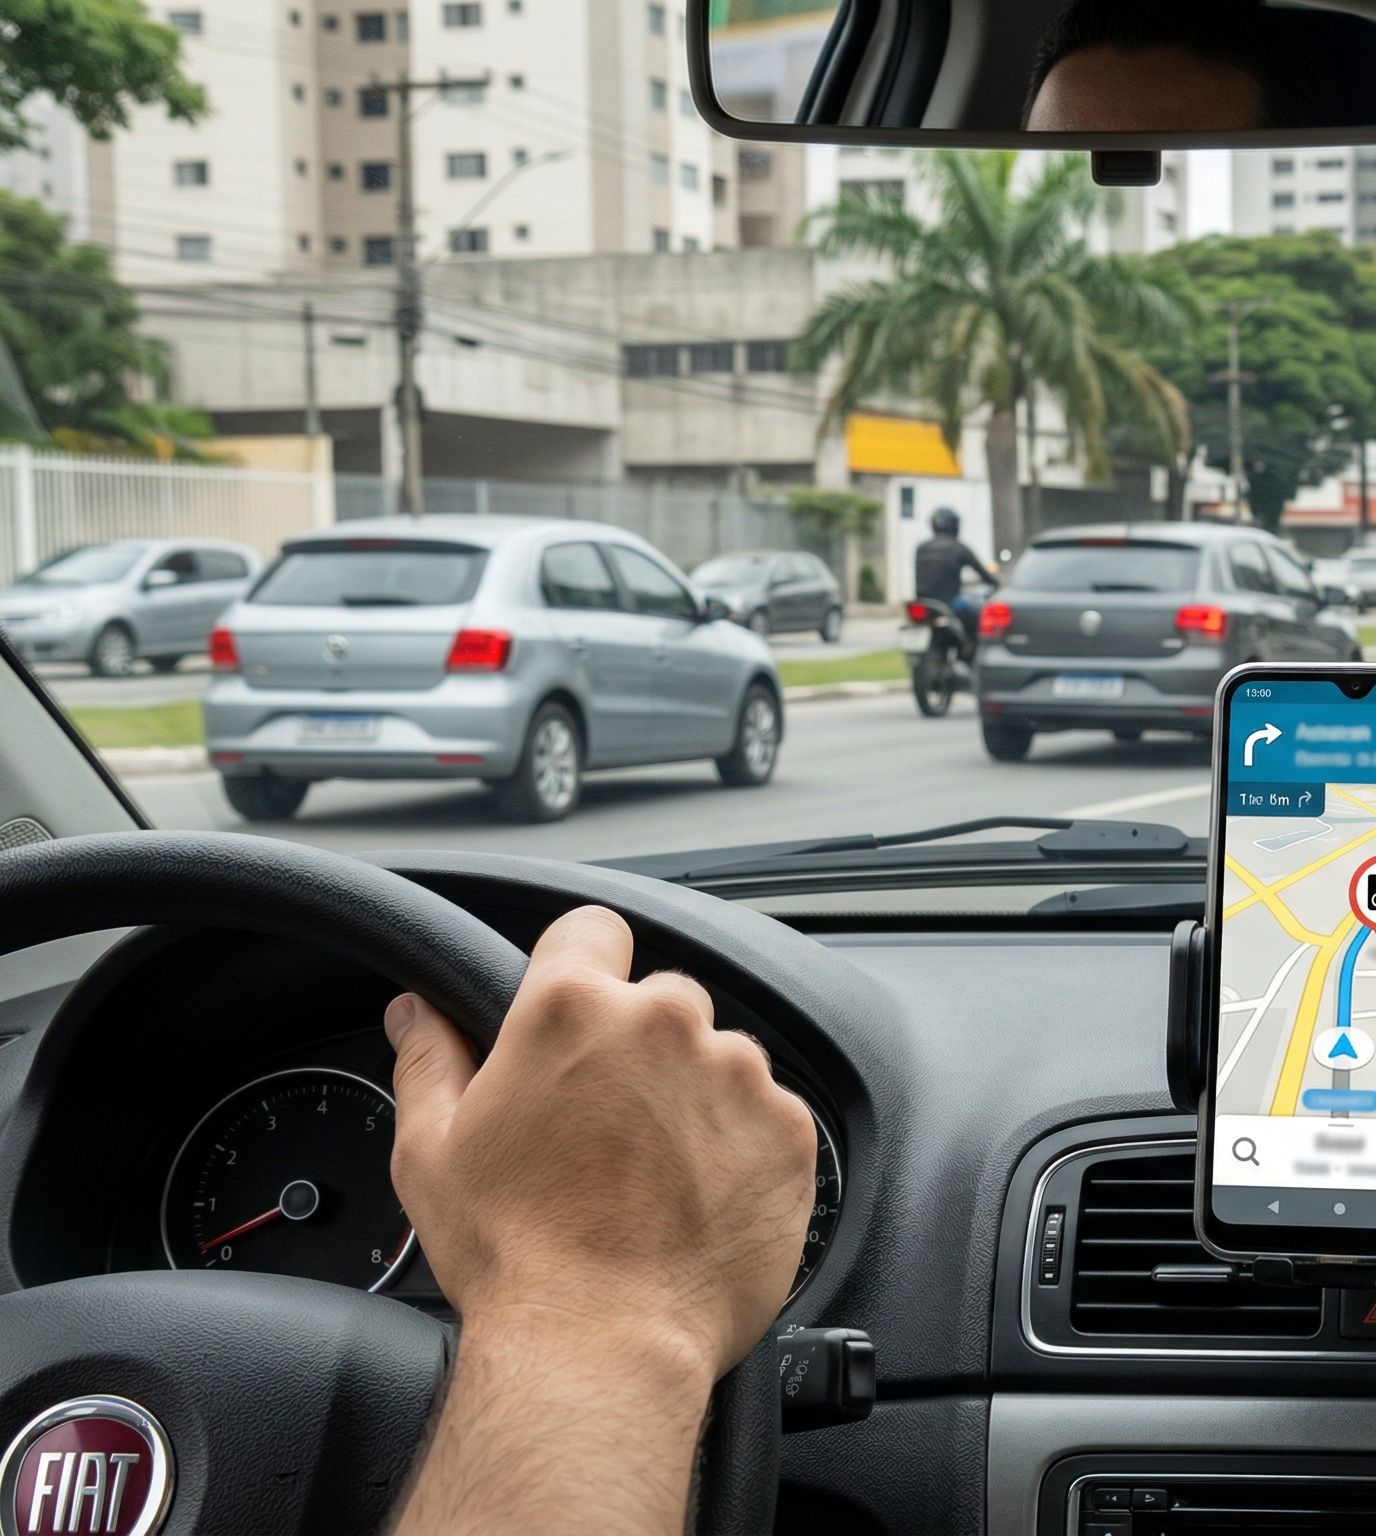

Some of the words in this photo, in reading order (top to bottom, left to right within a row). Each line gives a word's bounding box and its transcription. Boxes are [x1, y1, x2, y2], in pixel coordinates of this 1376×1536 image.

[316, 1100, 328, 1115] 4
[266, 1115, 277, 1131] 3
[365, 1116, 375, 1131] 5
[226, 1150, 237, 1165] 2
[209, 1197, 216, 1212] 1
[220, 1245, 232, 1261] 0
[370, 1248, 382, 1263] 8
[28, 1452, 140, 1533] FIAT
